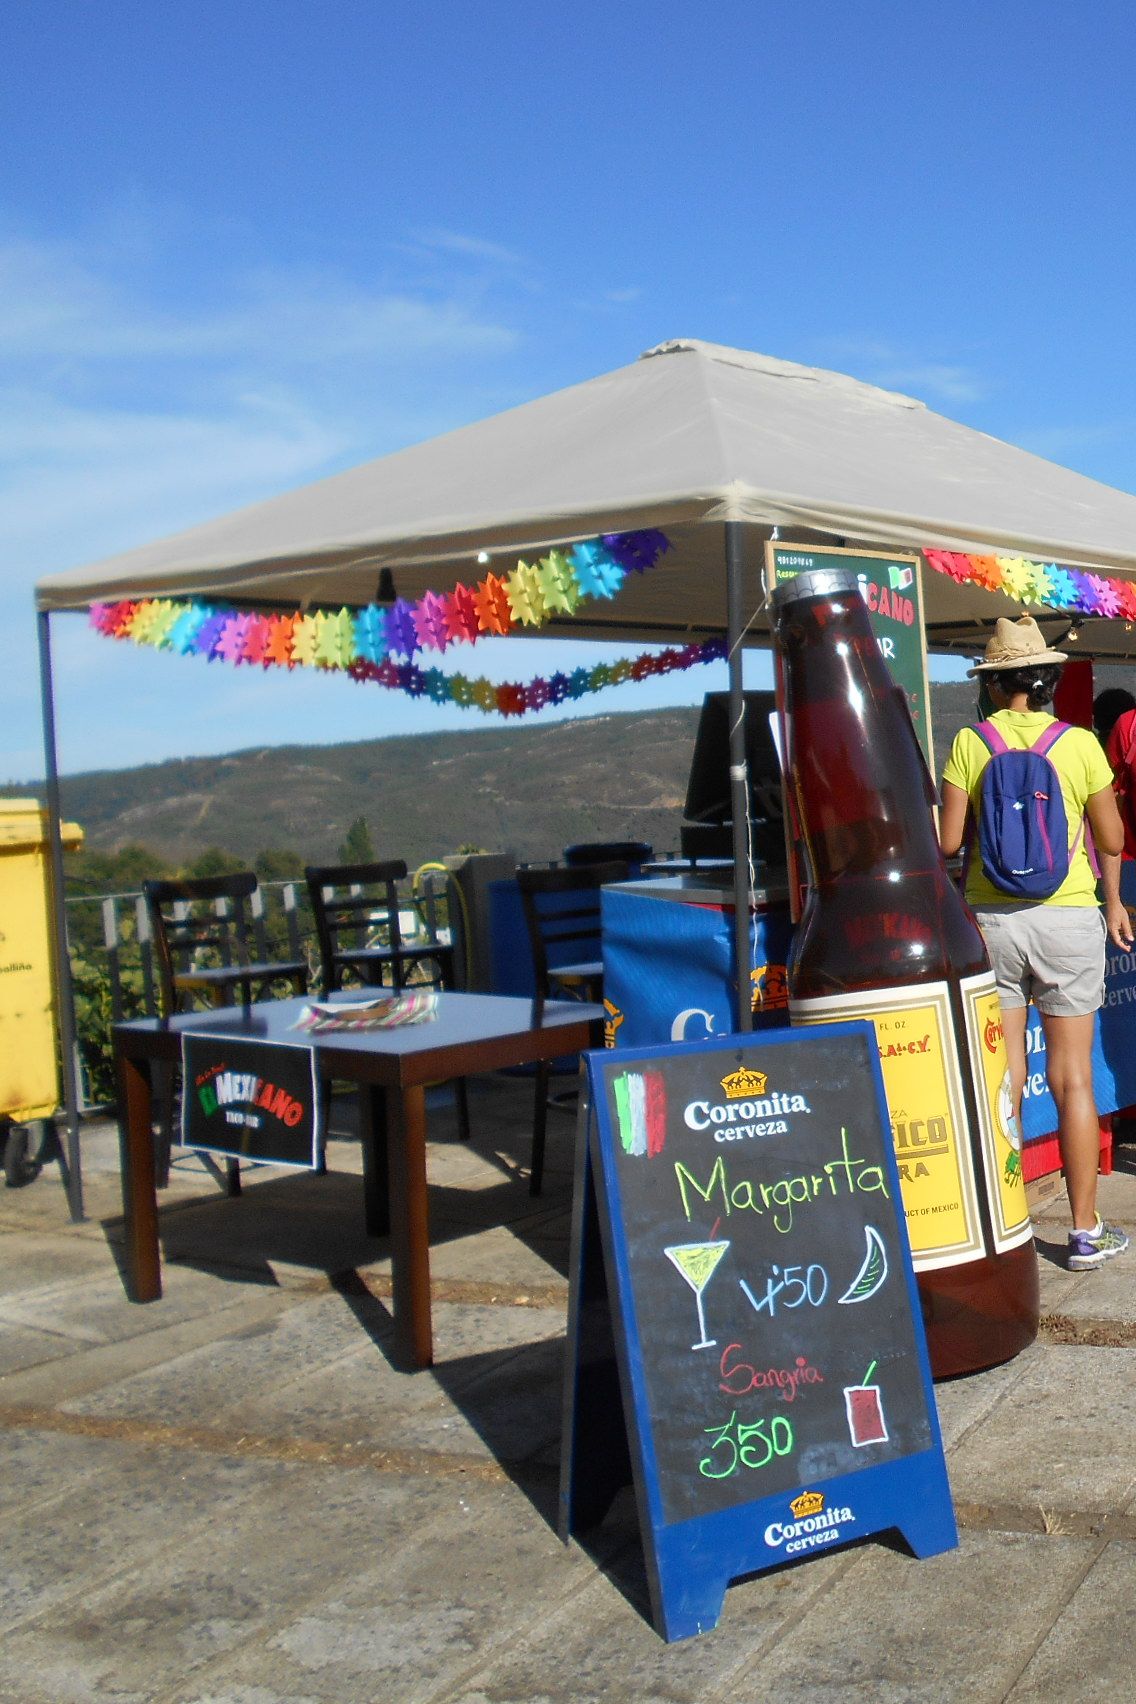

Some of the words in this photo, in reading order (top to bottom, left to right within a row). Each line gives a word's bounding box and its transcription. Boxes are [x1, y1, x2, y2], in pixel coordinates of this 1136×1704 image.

[684, 1092, 809, 1131] Coronita
[714, 1120, 788, 1143] cerveza
[674, 1127, 890, 1233] Margarita
[931, 1202, 959, 1214] MEXICO
[764, 1506, 856, 1547] Coronita
[785, 1528, 840, 1554] cerveza
